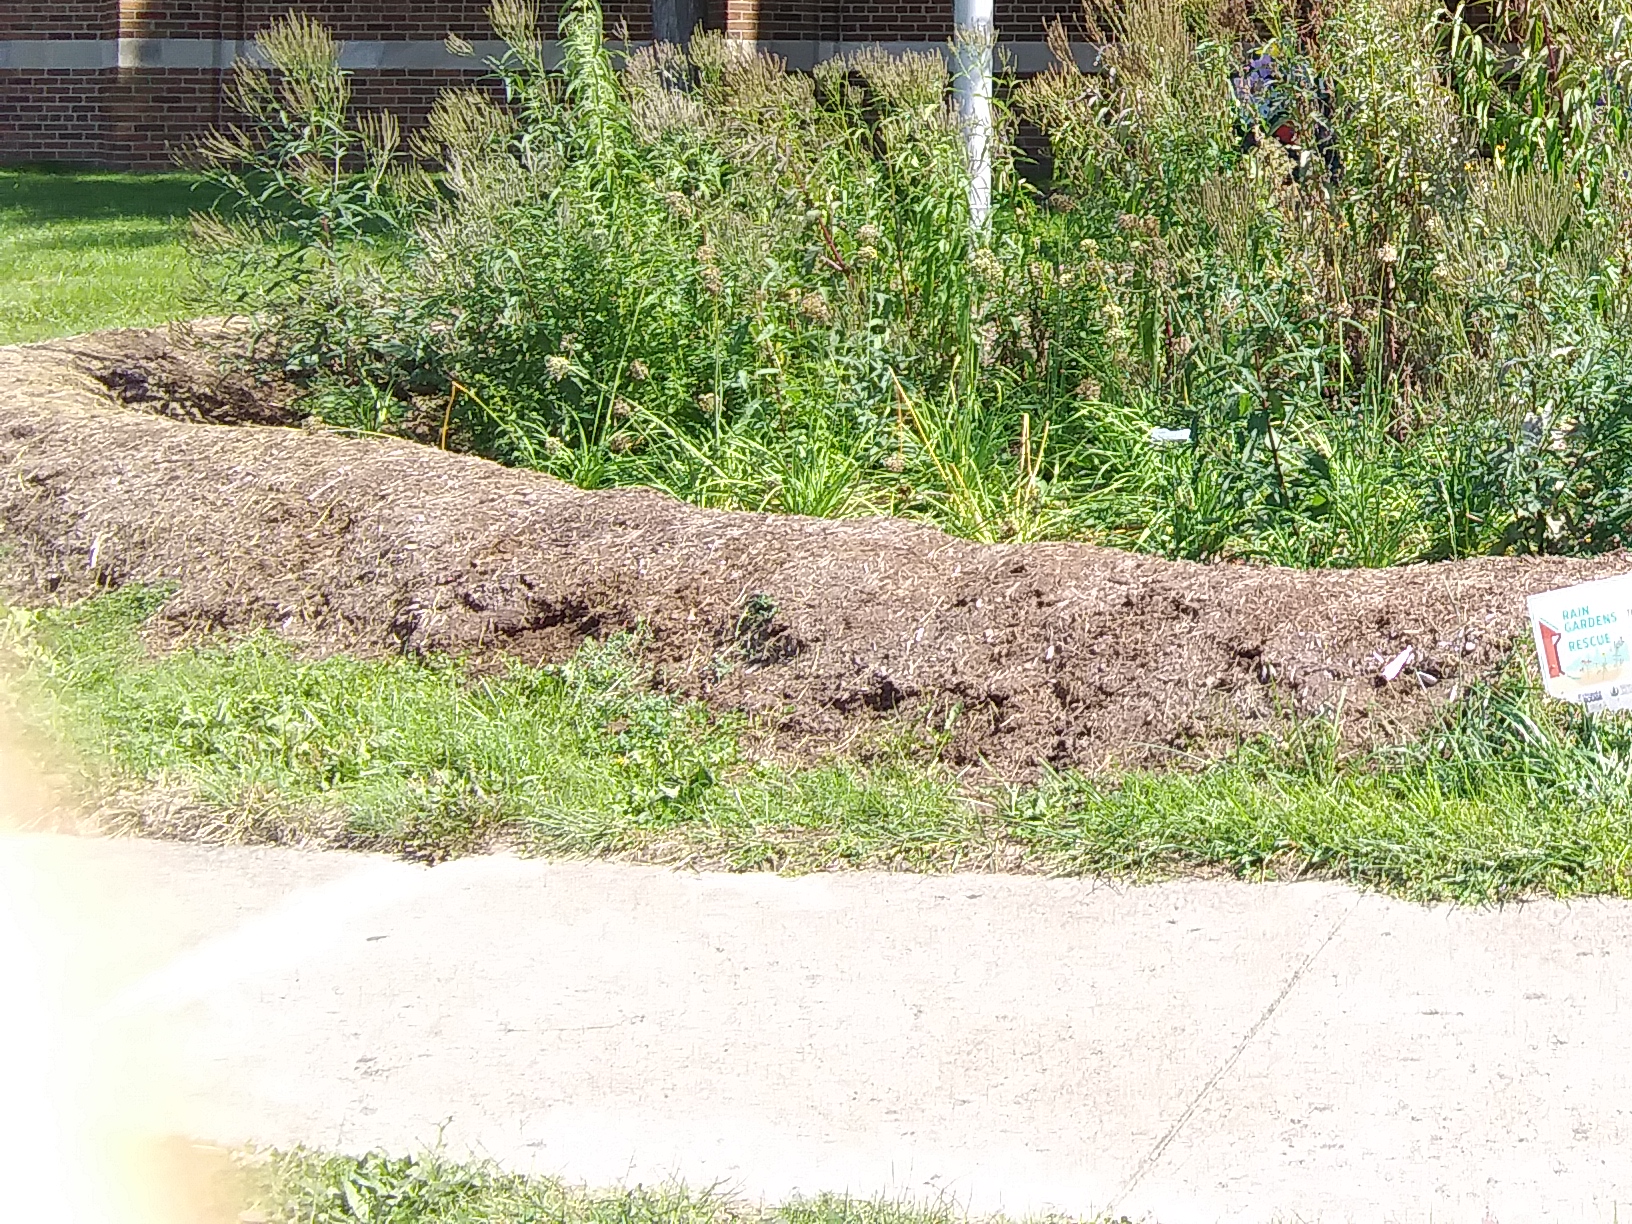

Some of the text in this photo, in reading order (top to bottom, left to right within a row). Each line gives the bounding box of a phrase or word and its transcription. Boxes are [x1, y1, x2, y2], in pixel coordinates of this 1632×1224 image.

[1562, 605, 1590, 621] RAIN
[1564, 611, 1617, 633] GARDENS
[1568, 633, 1611, 652] RESCUE
